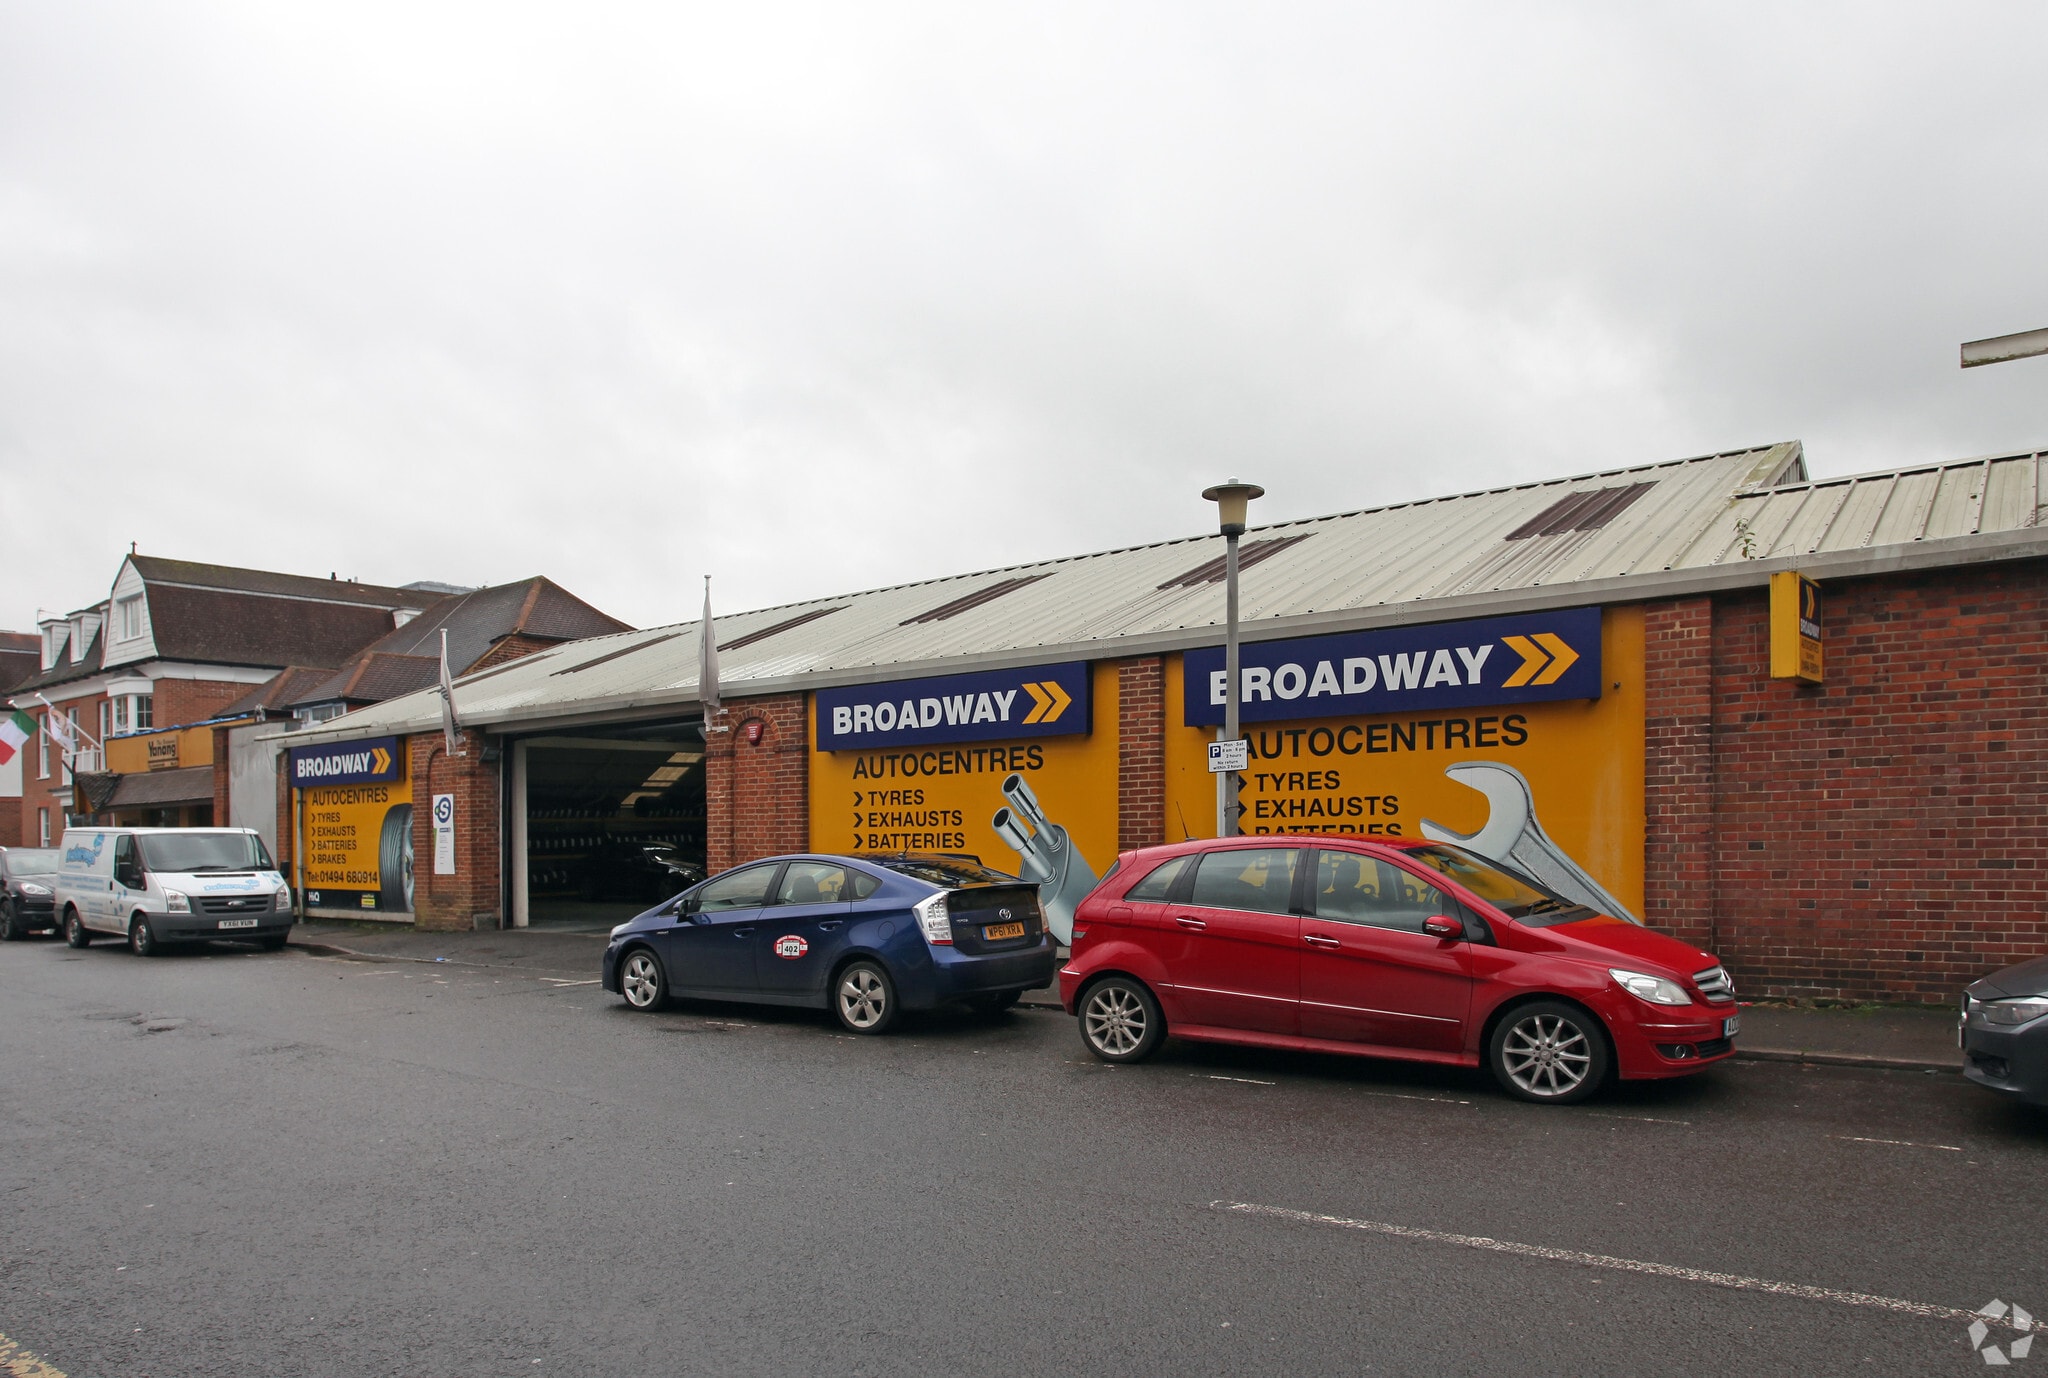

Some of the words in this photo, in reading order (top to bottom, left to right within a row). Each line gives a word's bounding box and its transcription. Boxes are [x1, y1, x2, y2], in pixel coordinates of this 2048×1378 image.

[1210, 644, 1494, 706] BROADWAY
[832, 689, 1018, 735] BROADWAY
[1240, 714, 1528, 760] AUTOCENTRES
[1212, 747, 1220, 757] P
[297, 752, 371, 778] BROADWAY
[852, 744, 1044, 780] AUTOCENTRES
[1254, 770, 1341, 793] TYRES
[312, 787, 388, 806] AUTOCENTRES
[867, 789, 925, 806] TYRES
[1254, 795, 1400, 819] EXHAUSTS
[317, 812, 341, 823] TYRES
[868, 810, 963, 828] EXHAUSTS
[317, 825, 357, 837] EXHAUSTS
[317, 839, 358, 851] BATTERIES
[868, 832, 966, 850] BATTERIES
[317, 853, 347, 865] BRAKES
[307, 871, 320, 883] Tel:
[319, 870, 345, 884] 01494
[346, 871, 378, 885] 680914
[784, 945, 799, 953] 402
